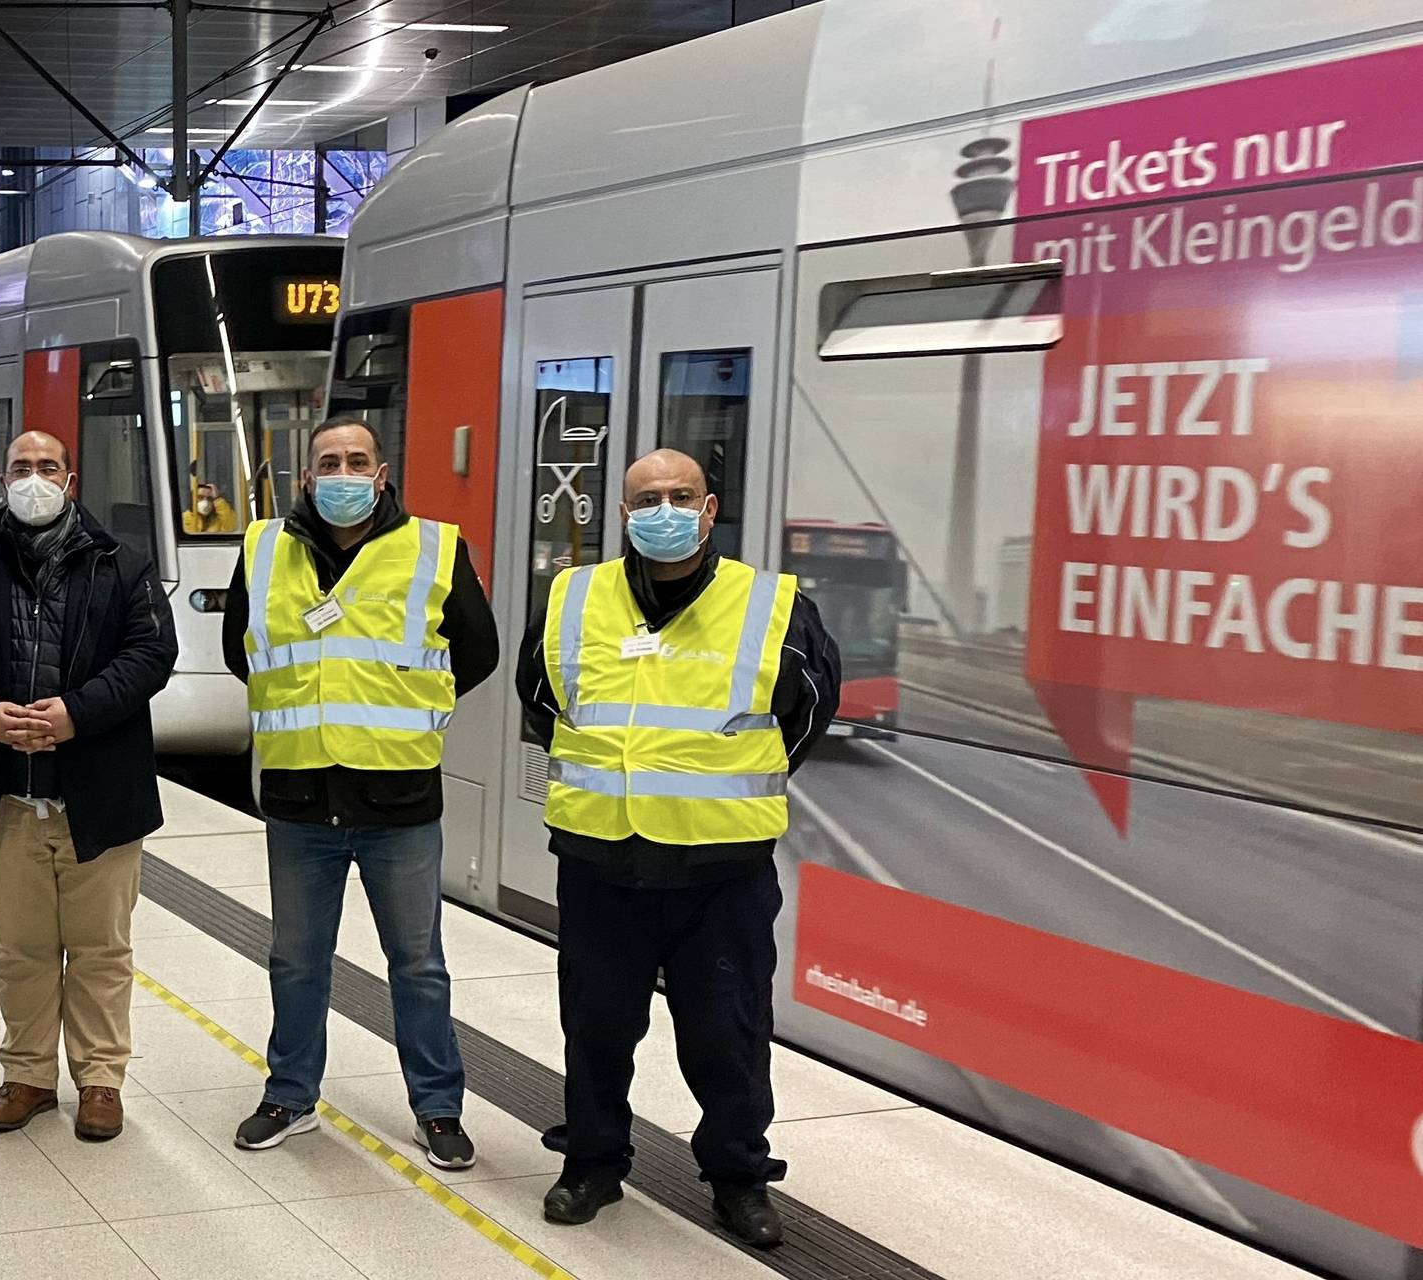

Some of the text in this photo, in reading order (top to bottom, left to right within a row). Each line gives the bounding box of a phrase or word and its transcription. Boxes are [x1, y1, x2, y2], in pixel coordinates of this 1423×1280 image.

[1035, 120, 1346, 206] Tickets nur
[1033, 177, 1423, 277] mit Kleingeld
[288, 283, 340, 314] U73
[1067, 358, 1271, 436] JETZT
[1066, 463, 1332, 548] WIRD'S
[805, 964, 928, 1027] rheinbahn.de
